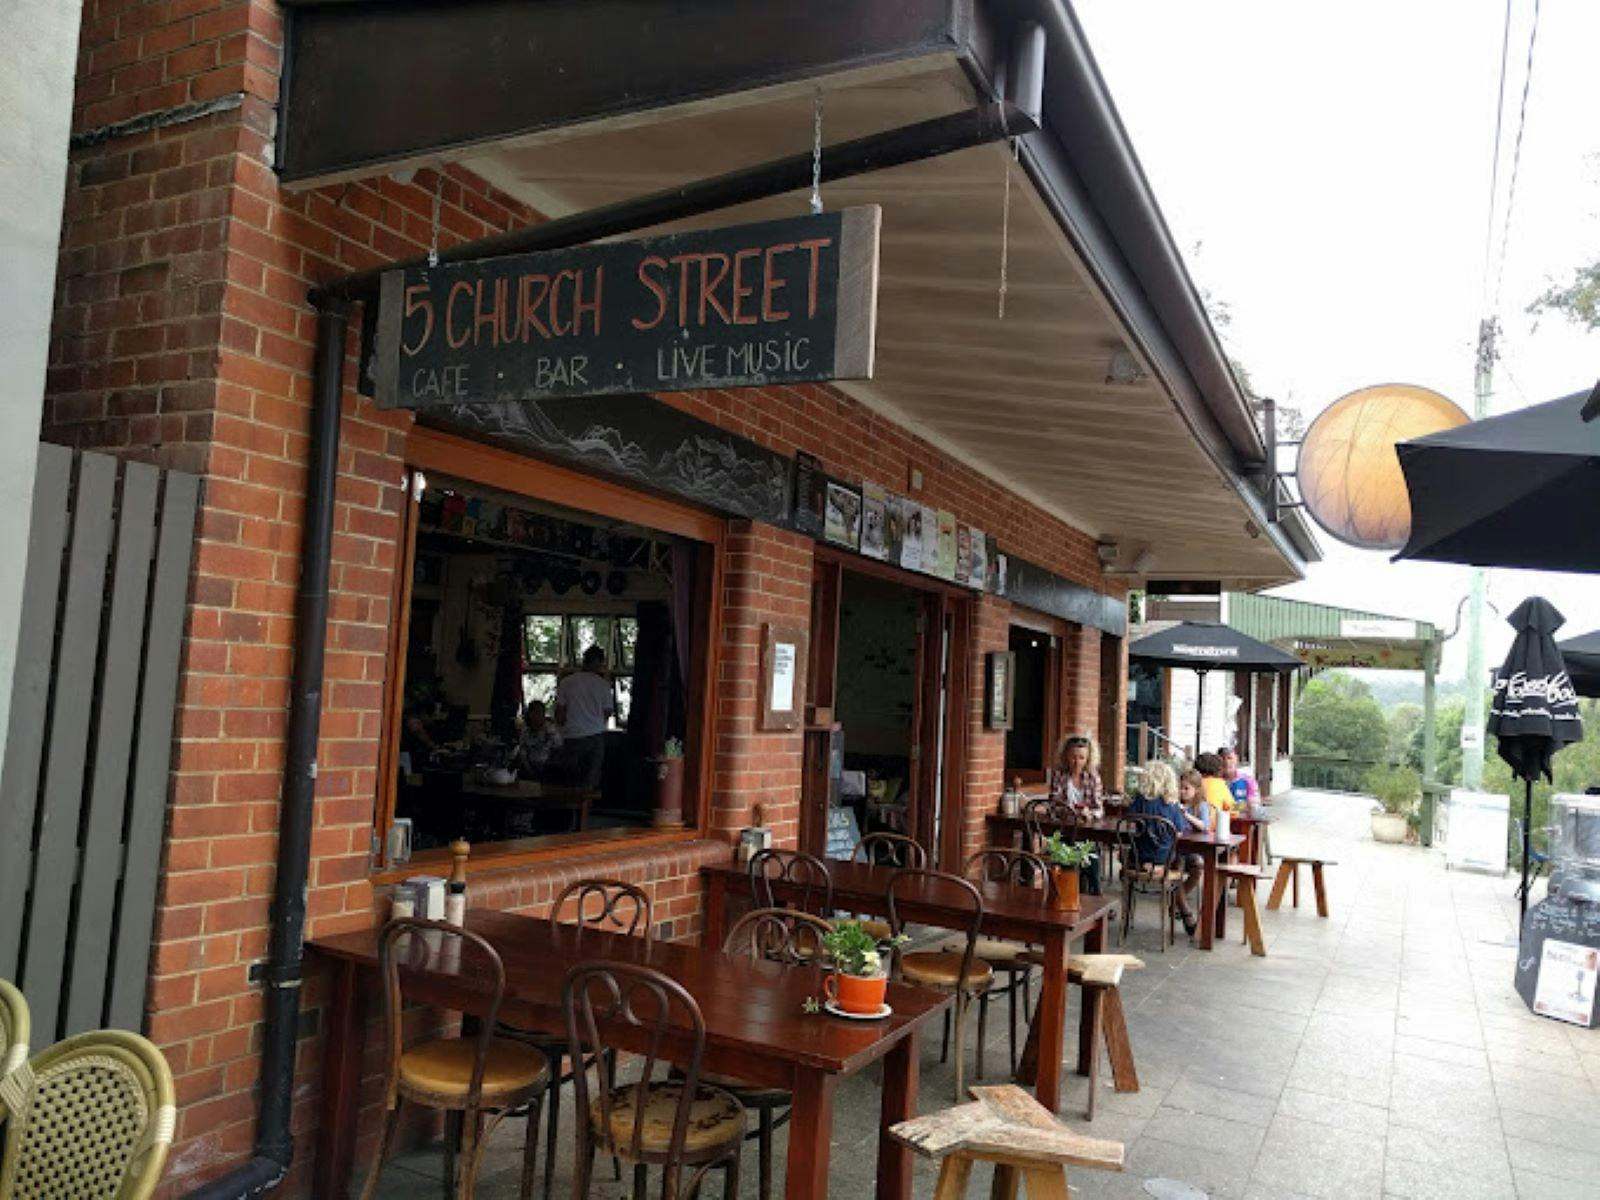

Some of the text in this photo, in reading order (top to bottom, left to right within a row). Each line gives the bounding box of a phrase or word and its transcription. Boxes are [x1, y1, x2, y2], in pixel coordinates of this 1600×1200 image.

[403, 237, 833, 356] 5 CHURCH STREET
[412, 363, 471, 397] CAFE
[535, 355, 589, 390] BAR
